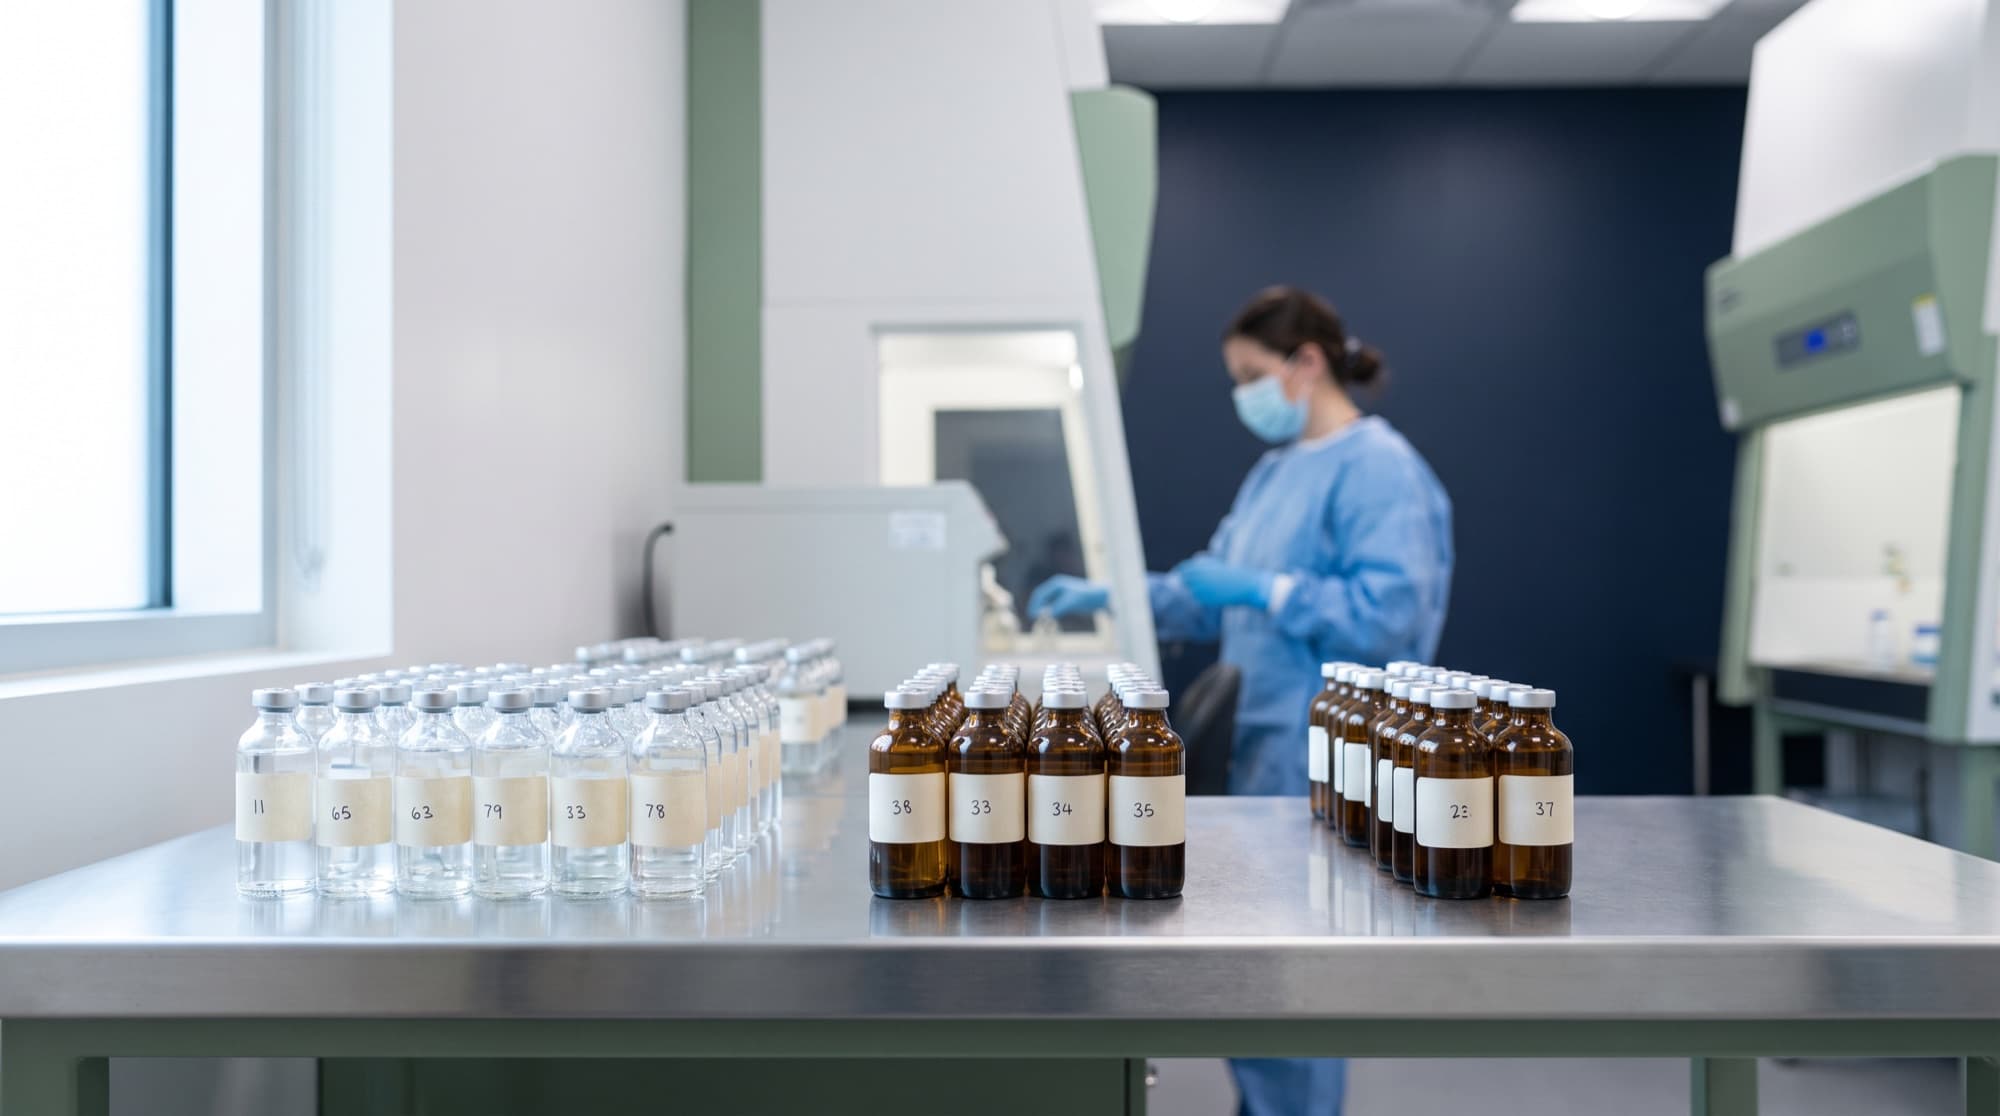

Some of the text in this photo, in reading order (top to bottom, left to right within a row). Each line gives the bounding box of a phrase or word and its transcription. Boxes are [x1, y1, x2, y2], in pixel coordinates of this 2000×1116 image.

[331, 805, 351, 821] 65
[411, 805, 433, 821] 63
[484, 803, 503, 820] 79
[567, 804, 587, 820] 33
[646, 803, 666, 820] 78
[892, 800, 912, 816] 38
[971, 800, 991, 816] 33
[1052, 801, 1072, 817] 34
[1133, 803, 1154, 818] 35
[1535, 801, 1554, 817] 37
